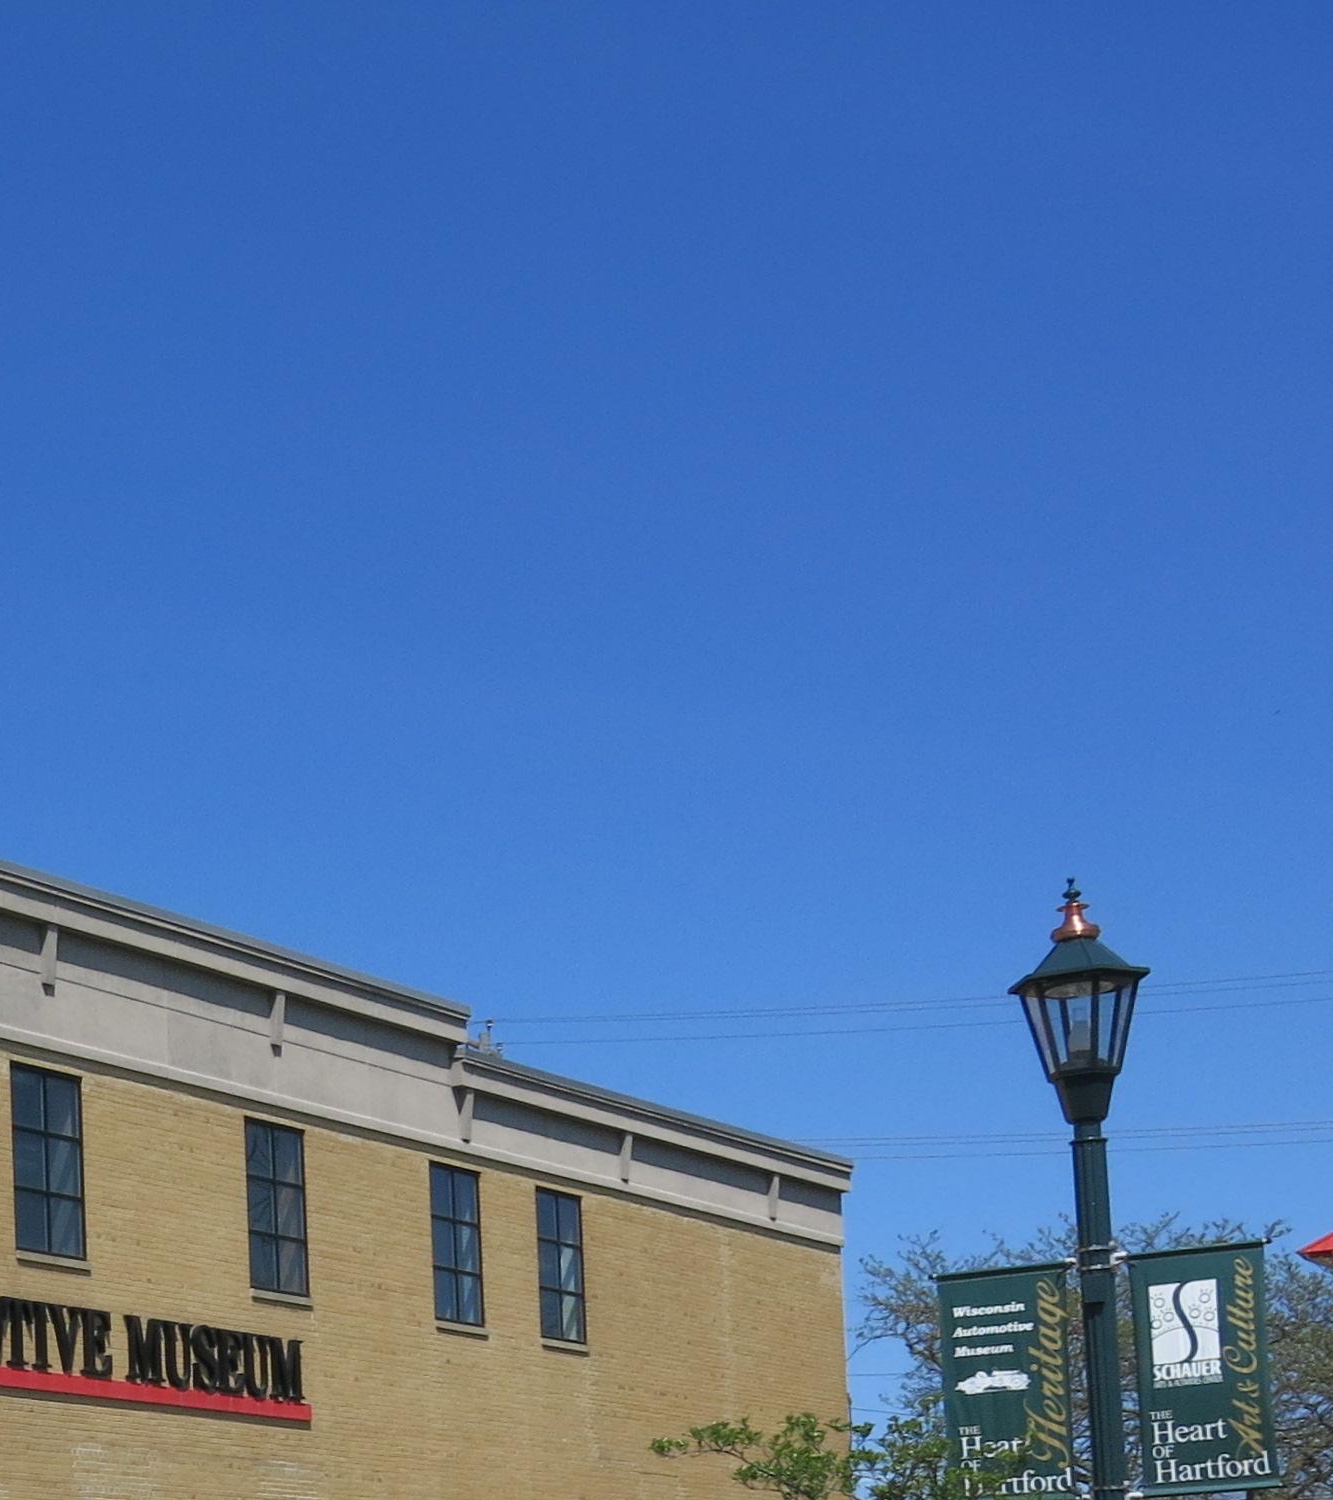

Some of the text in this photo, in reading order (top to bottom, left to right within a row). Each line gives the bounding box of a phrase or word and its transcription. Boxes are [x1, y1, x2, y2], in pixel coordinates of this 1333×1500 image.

[952, 1301, 1025, 1318] Wisconsin
[1222, 1256, 1258, 1374] Culture
[952, 1321, 1034, 1338] Automotive
[124, 1314, 307, 1405] MUSEUM
[954, 1344, 1014, 1358] Museum
[1023, 1277, 1071, 1469] Heritage
[1153, 1359, 1222, 1381] SCHAUER
[1149, 1410, 1173, 1420] THE
[958, 1425, 981, 1436] THE
[1151, 1418, 1228, 1445] Heart
[1152, 1445, 1174, 1459] OF
[1154, 1450, 1272, 1484] Hartford
